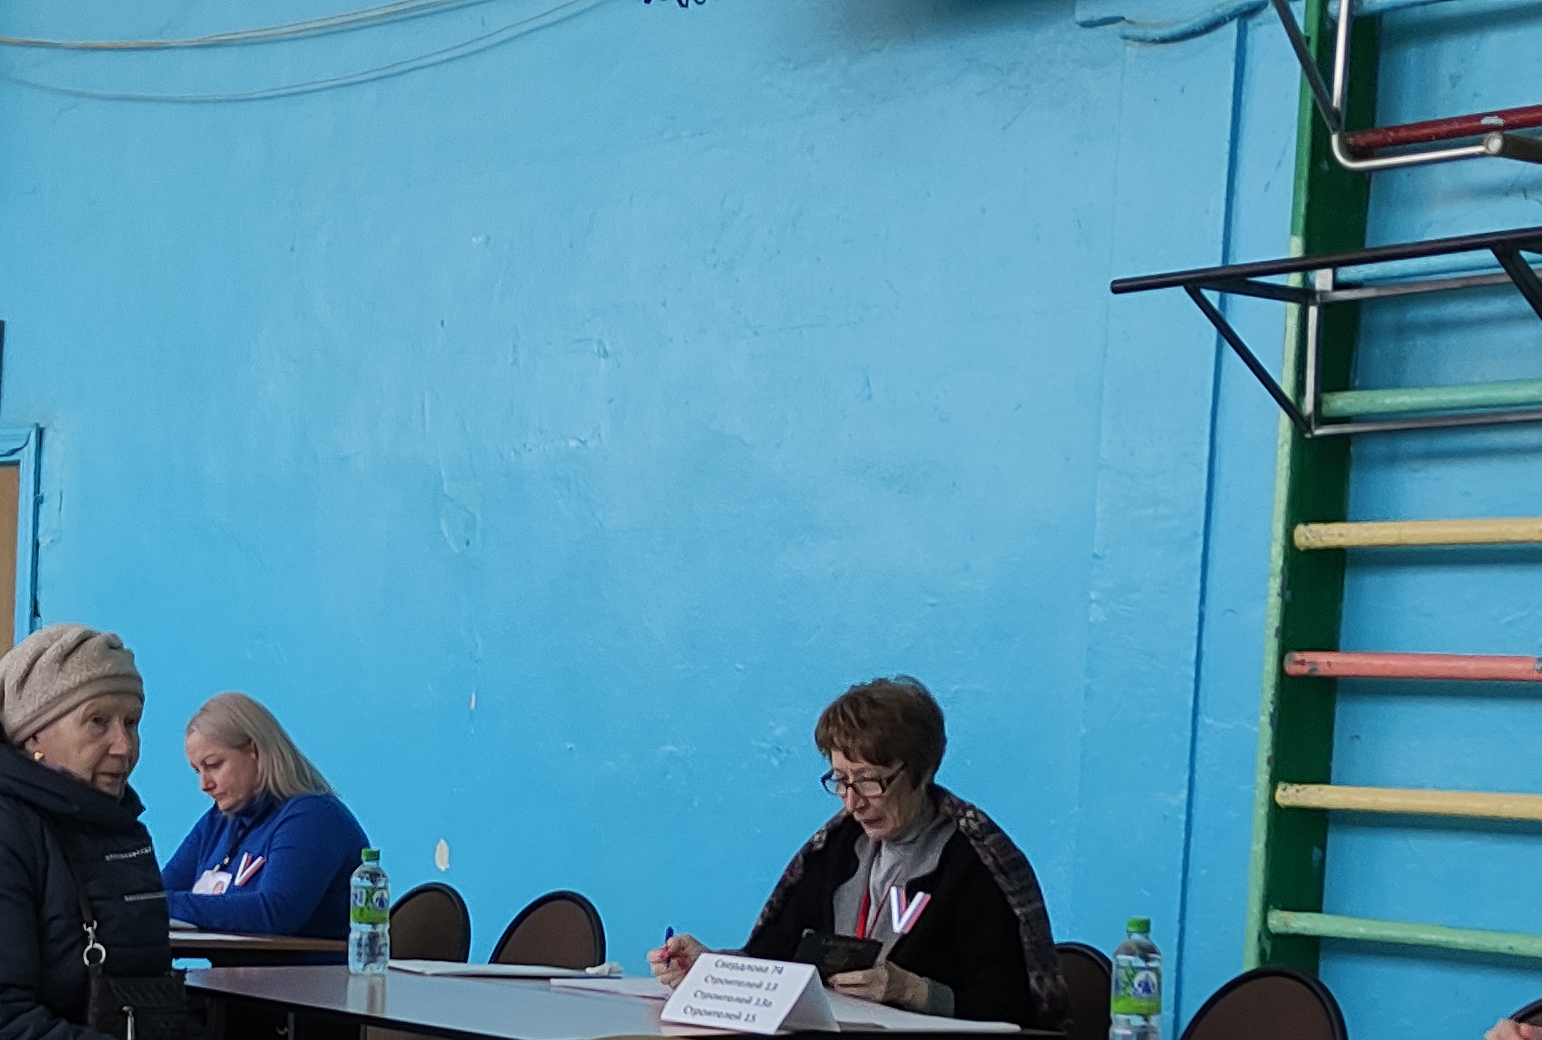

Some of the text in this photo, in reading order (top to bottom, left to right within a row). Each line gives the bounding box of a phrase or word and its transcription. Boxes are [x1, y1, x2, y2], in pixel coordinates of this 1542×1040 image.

[704, 974, 764, 989] Строителей
[693, 989, 753, 1004] Строителей
[683, 1004, 758, 1023] Строителей 15
